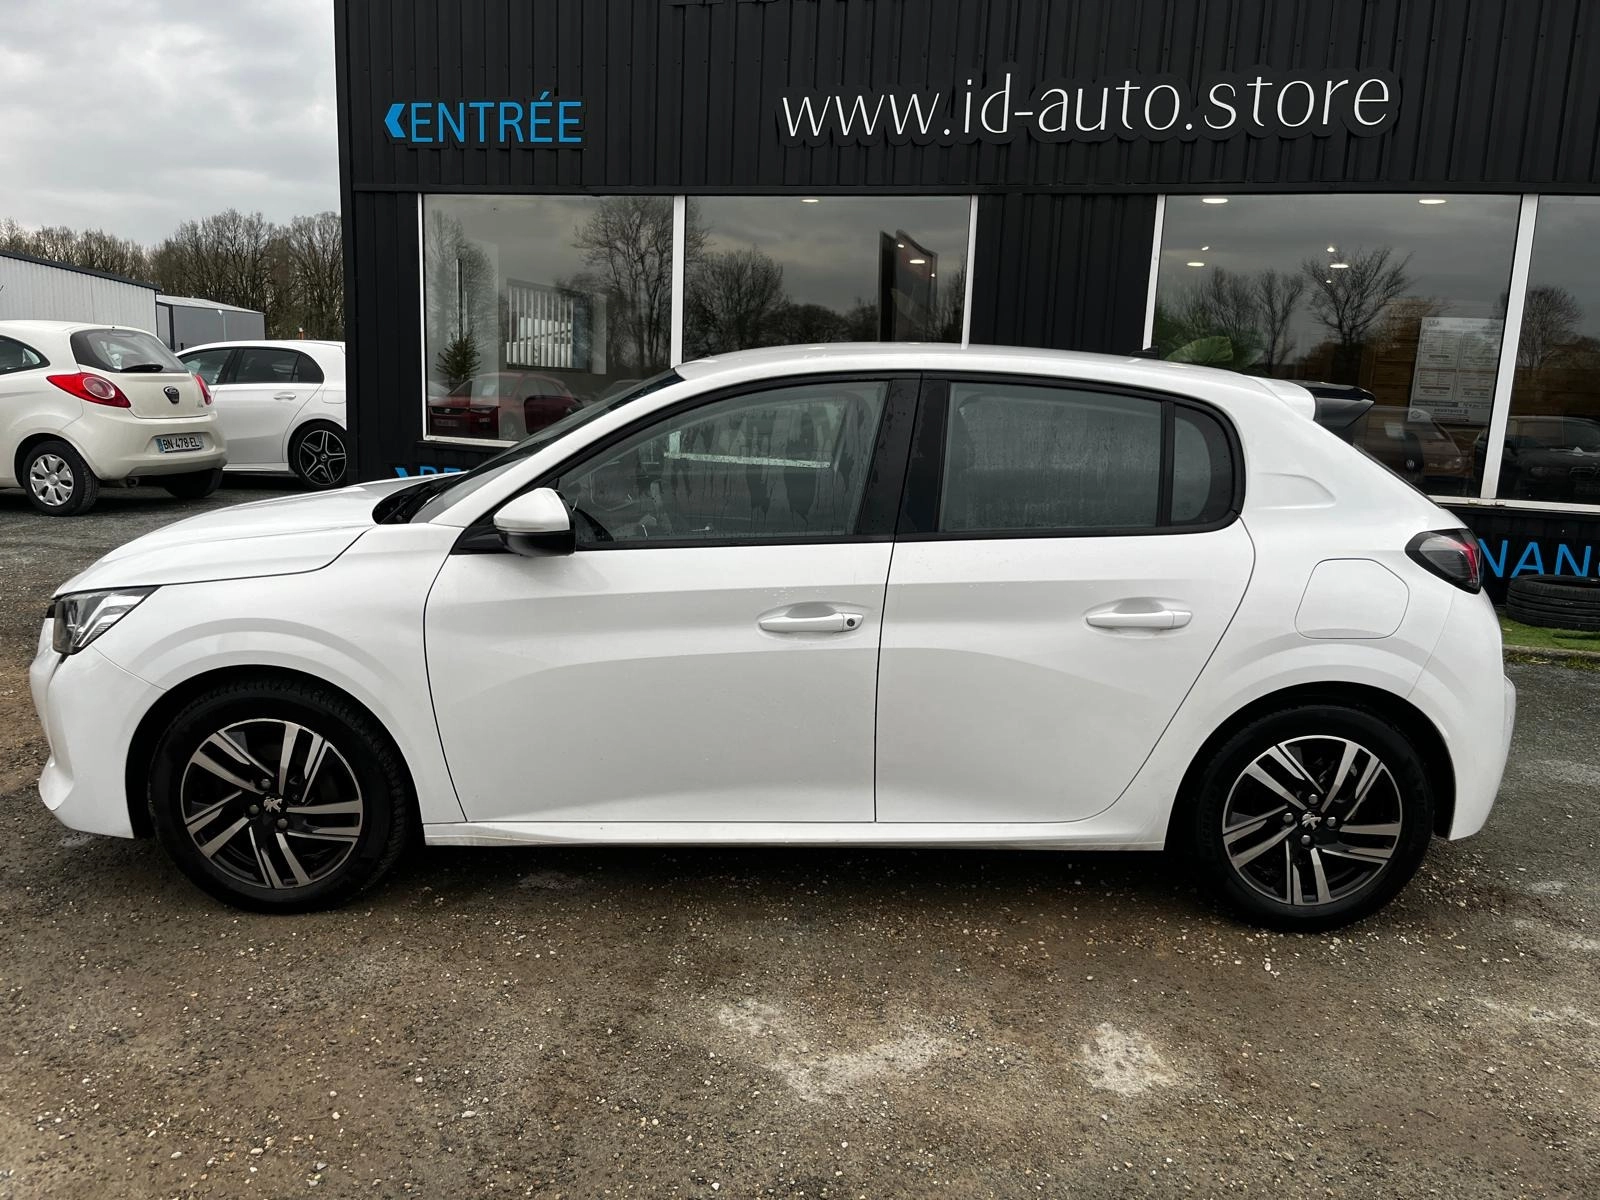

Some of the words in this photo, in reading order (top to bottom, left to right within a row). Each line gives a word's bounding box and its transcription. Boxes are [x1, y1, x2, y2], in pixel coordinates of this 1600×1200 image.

[411, 91, 582, 143] ENTRÉE
[782, 73, 1390, 137] www.id-auto.store
[163, 439, 174, 449] BN
[175, 437, 190, 449] 478
[189, 437, 200, 447] EL
